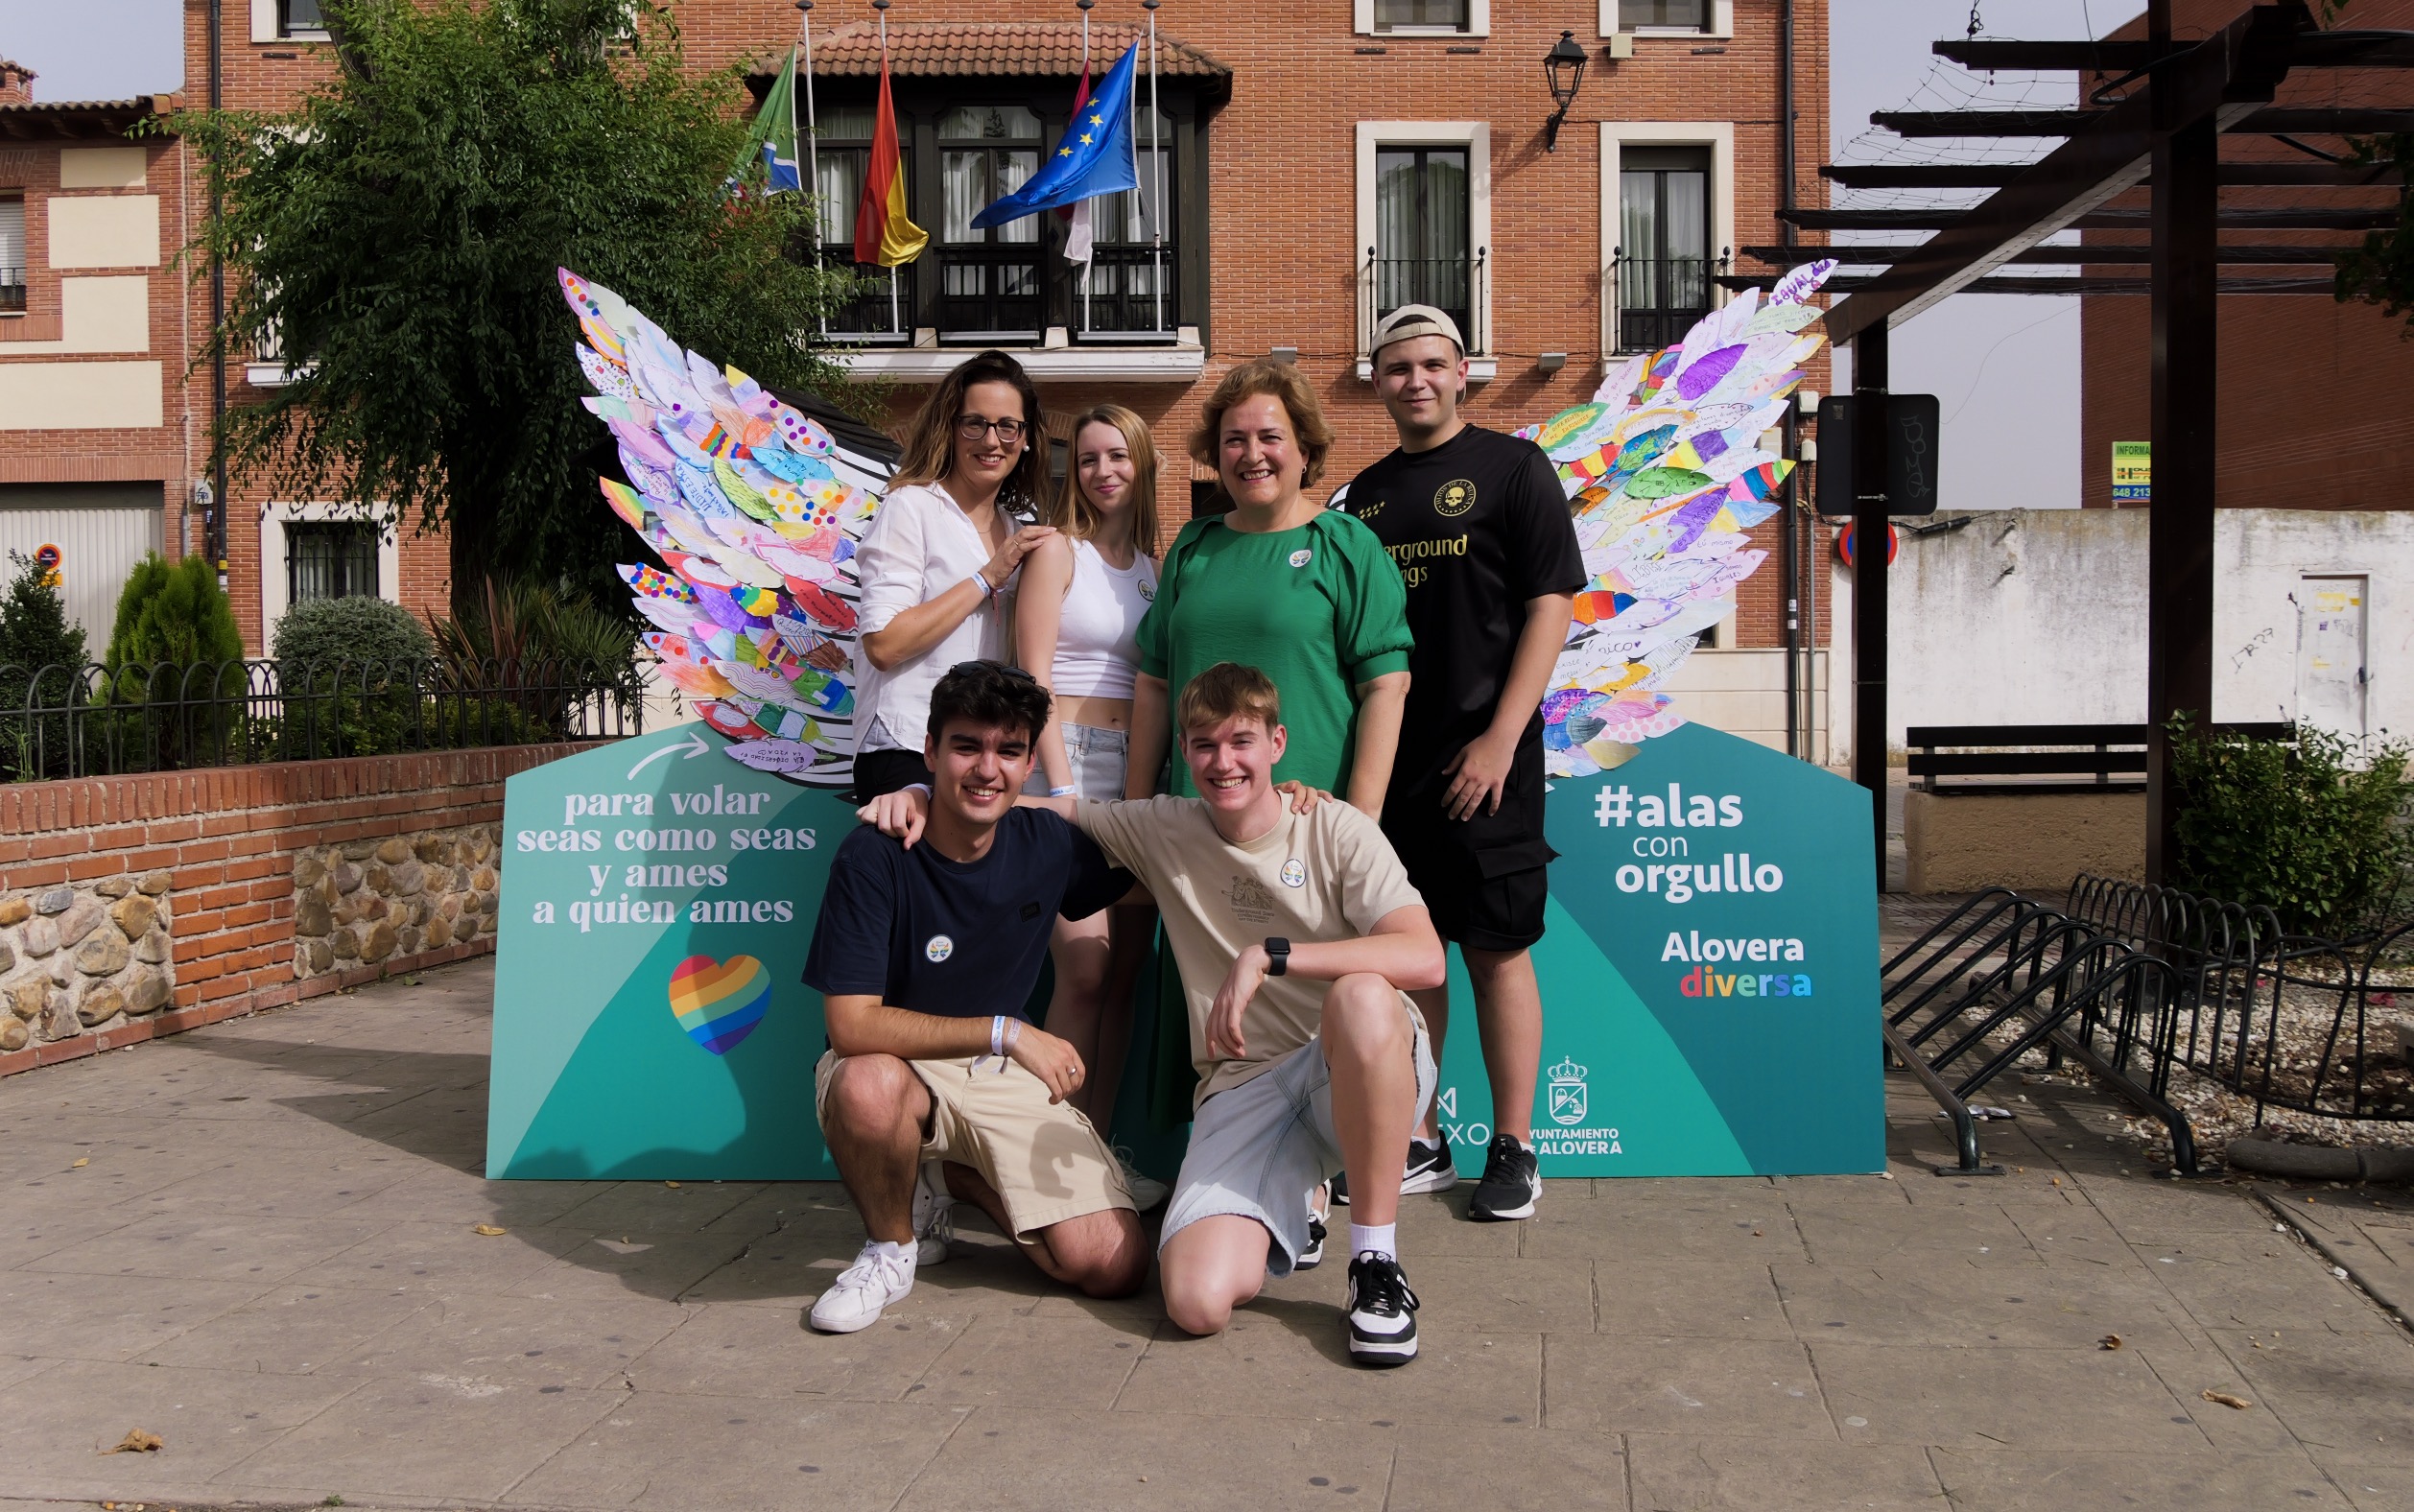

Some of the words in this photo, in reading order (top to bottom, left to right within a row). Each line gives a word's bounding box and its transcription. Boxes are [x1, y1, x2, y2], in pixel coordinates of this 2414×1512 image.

[2117, 445, 2150, 456] INFORMA
[2113, 487, 2130, 497] 648
[1384, 533, 1468, 566] erground
[1401, 566, 1428, 588] ngs
[564, 791, 655, 825] para
[670, 784, 770, 815] volar
[1594, 782, 1743, 828] #alas
[516, 828, 602, 853] seas
[614, 827, 717, 853] como
[730, 826, 816, 852] seas
[1632, 836, 1689, 858] con
[588, 863, 611, 896] y
[625, 862, 728, 888] ames
[1615, 853, 1784, 904] orgullo
[532, 900, 555, 925] a
[568, 892, 675, 933] quien
[689, 899, 793, 924] ames
[1661, 931, 1804, 962] Alovera
[1679, 965, 1812, 999] diversa
[1437, 1122, 1490, 1146] XO
[1529, 1128, 1619, 1140] YUNTAMIENTO
[1539, 1141, 1622, 1155] ALOVERA
